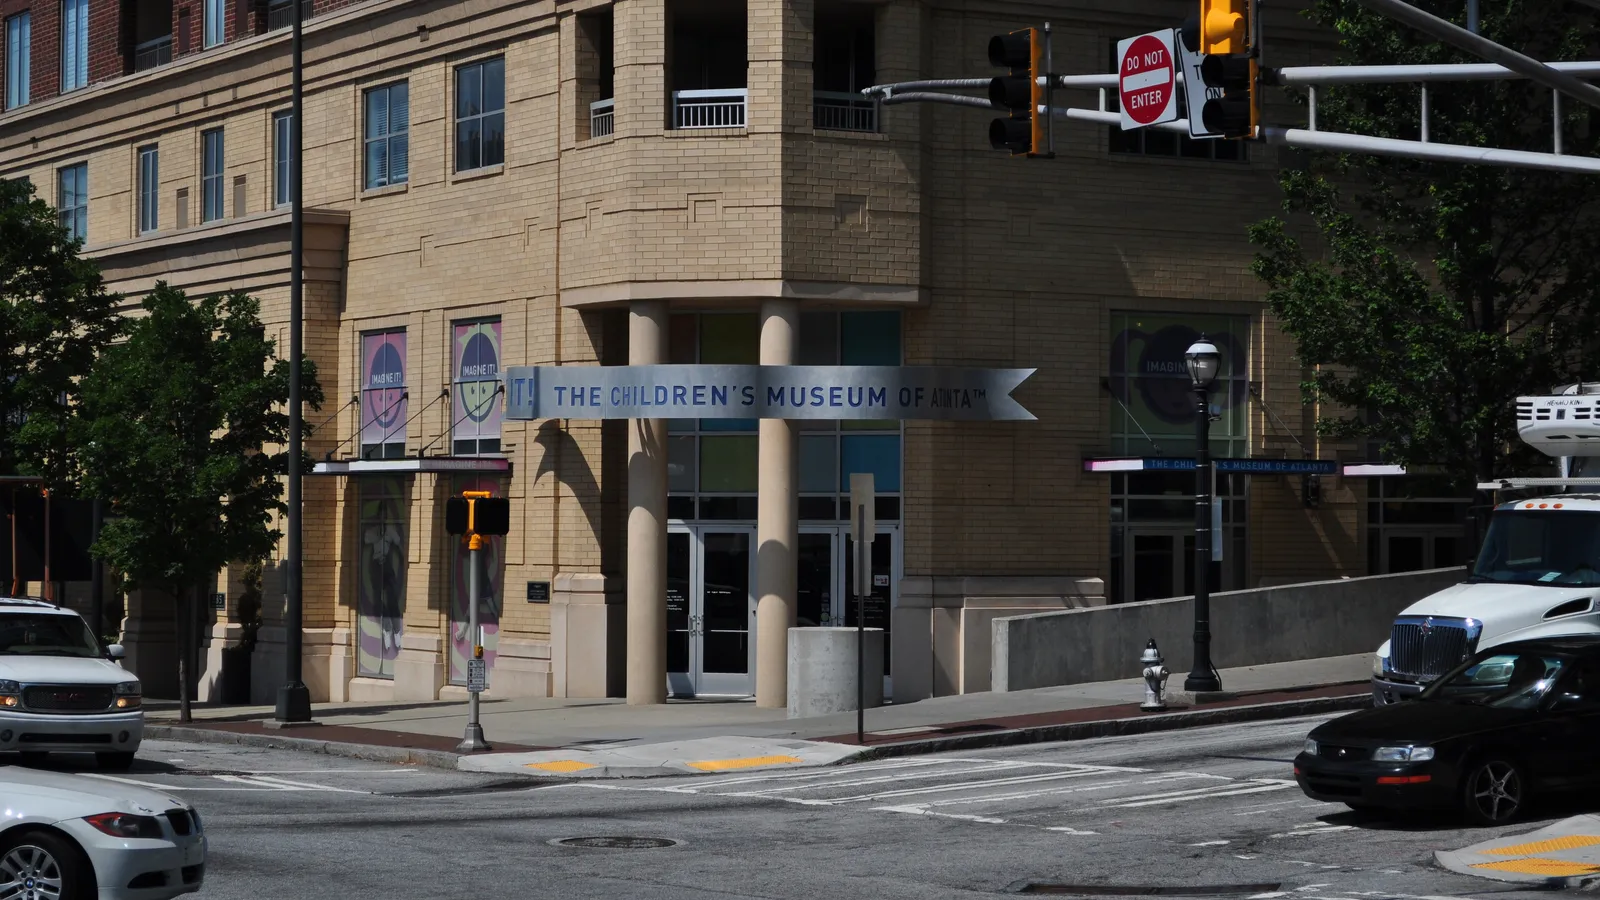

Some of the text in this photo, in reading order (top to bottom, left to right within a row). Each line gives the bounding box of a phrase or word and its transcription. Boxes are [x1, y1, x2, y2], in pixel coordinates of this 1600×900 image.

[1127, 49, 1164, 71] DO NOT
[1131, 90, 1163, 109] ENTER
[1146, 360, 1189, 373] IMAGIN
[553, 386, 601, 407] THE
[610, 385, 755, 407] CHILDREN'S
[767, 386, 887, 408] MUSEUM
[899, 387, 925, 408] OF
[1151, 459, 1168, 469] THE
[1233, 461, 1271, 471] MUSEUM
[1275, 462, 1286, 471] OF
[1290, 463, 1329, 472] ATLANTA
